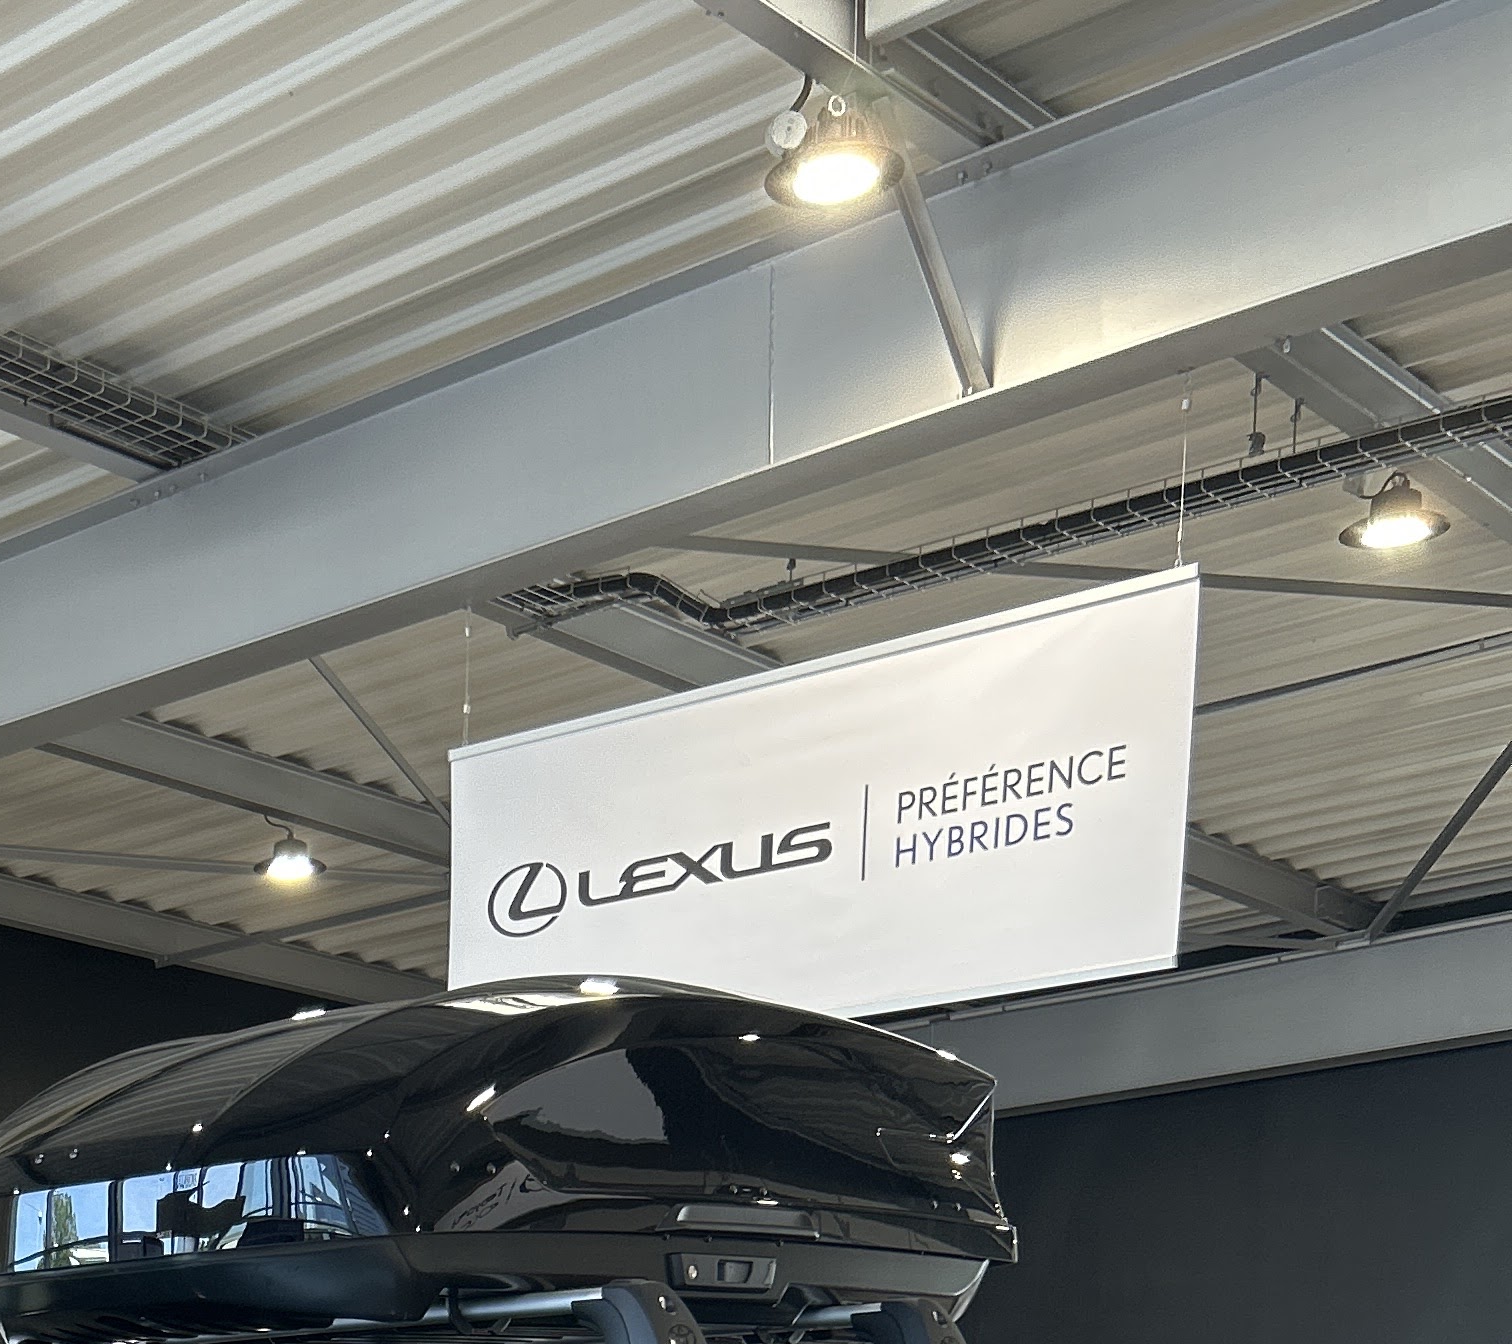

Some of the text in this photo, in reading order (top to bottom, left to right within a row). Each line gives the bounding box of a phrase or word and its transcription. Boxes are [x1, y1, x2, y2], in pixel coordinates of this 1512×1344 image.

[896, 744, 1128, 824] PRÉFÉRENCE
[578, 821, 832, 907] LEXUS
[894, 803, 1075, 868] HYBRIDES
